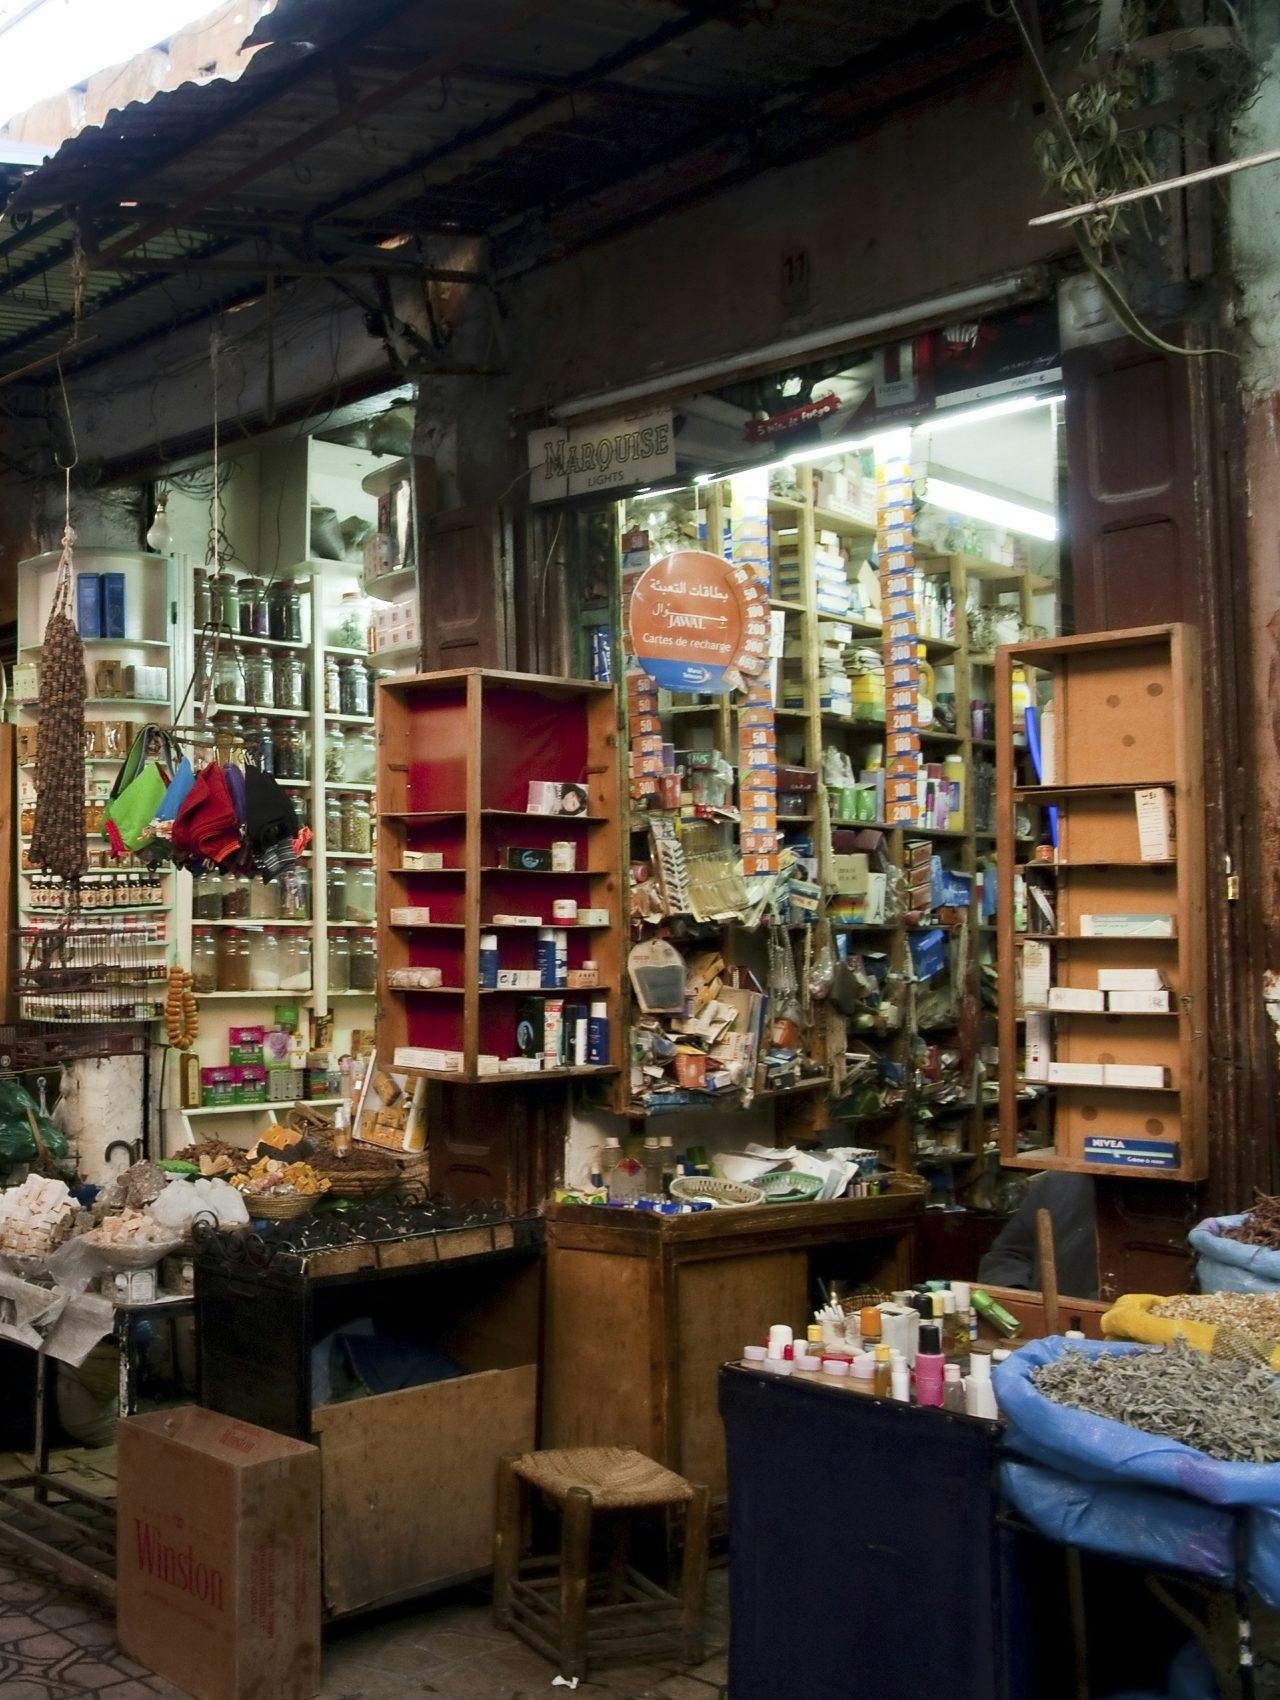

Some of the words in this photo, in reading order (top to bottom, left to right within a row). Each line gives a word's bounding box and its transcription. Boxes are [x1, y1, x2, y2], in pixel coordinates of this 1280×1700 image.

[543, 424, 670, 480] MARQUISE
[587, 471, 625, 487] LIGHTS
[649, 578, 687, 596] التعبئة
[688, 582, 729, 603] بطاقات
[667, 615, 708, 630] JAWAL
[642, 632, 673, 645] Cartes
[675, 636, 688, 647] de
[689, 638, 732, 653] recharge
[890, 646, 910, 661] 300
[637, 679, 651, 692] 50
[638, 699, 651, 712] 50
[892, 691, 911, 706] 300
[639, 719, 653, 732] 50
[893, 714, 912, 729] 200
[641, 739, 654, 752] 50
[752, 731, 767, 745] 50
[894, 737, 912, 752] 100
[642, 760, 655, 772] 50
[639, 781, 655, 794] 300
[893, 782, 911, 797] 100
[893, 806, 912, 821] 200
[755, 858, 769, 872] 20
[1092, 1139, 1126, 1149] NIVEA
[219, 1429, 257, 1453] Winston
[133, 1518, 225, 1612] Winston
